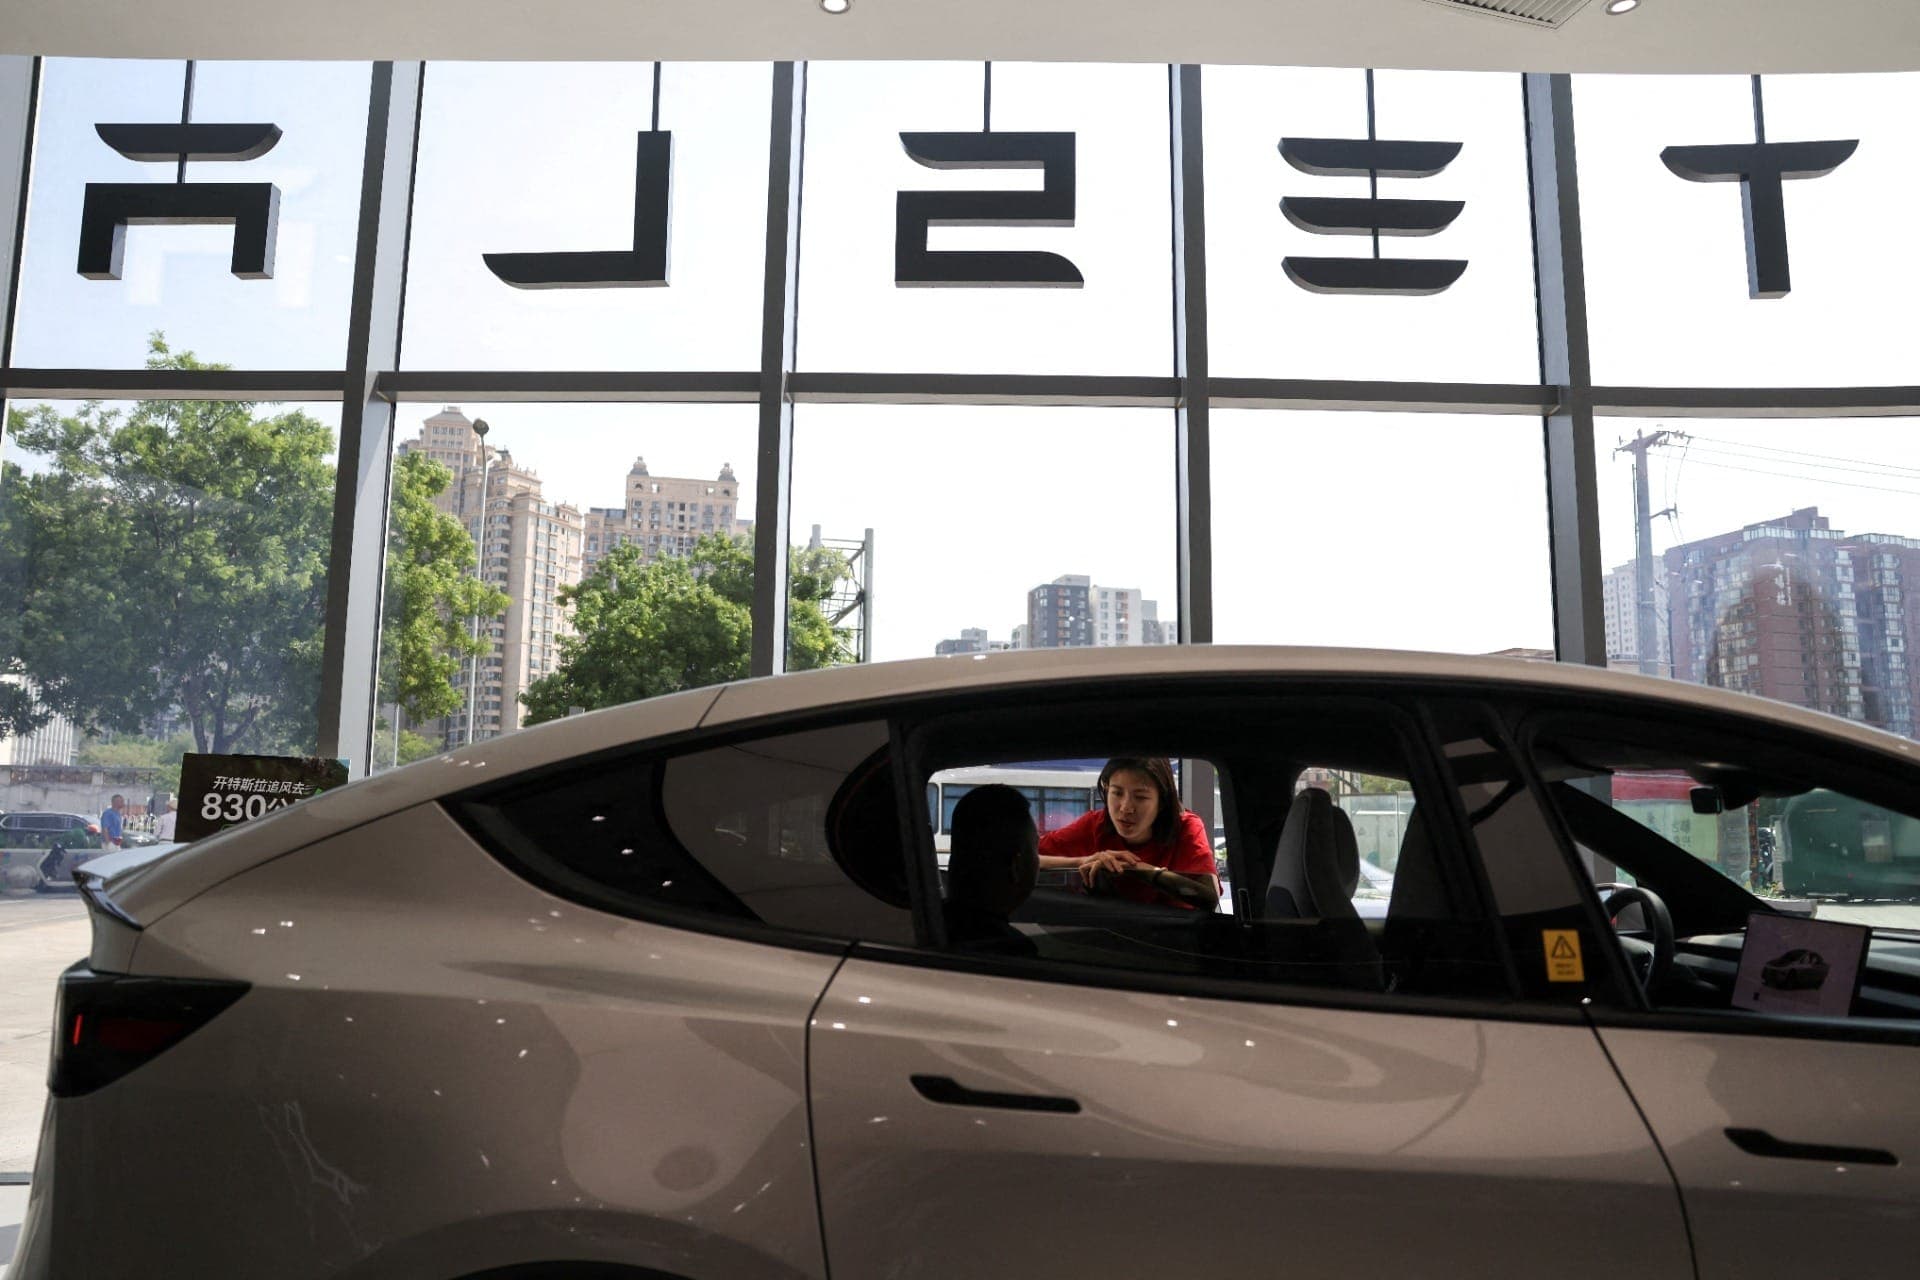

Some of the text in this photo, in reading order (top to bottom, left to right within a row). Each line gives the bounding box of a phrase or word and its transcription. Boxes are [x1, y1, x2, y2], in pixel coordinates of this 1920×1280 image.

[212, 775, 305, 795] 开特斯拉追风去
